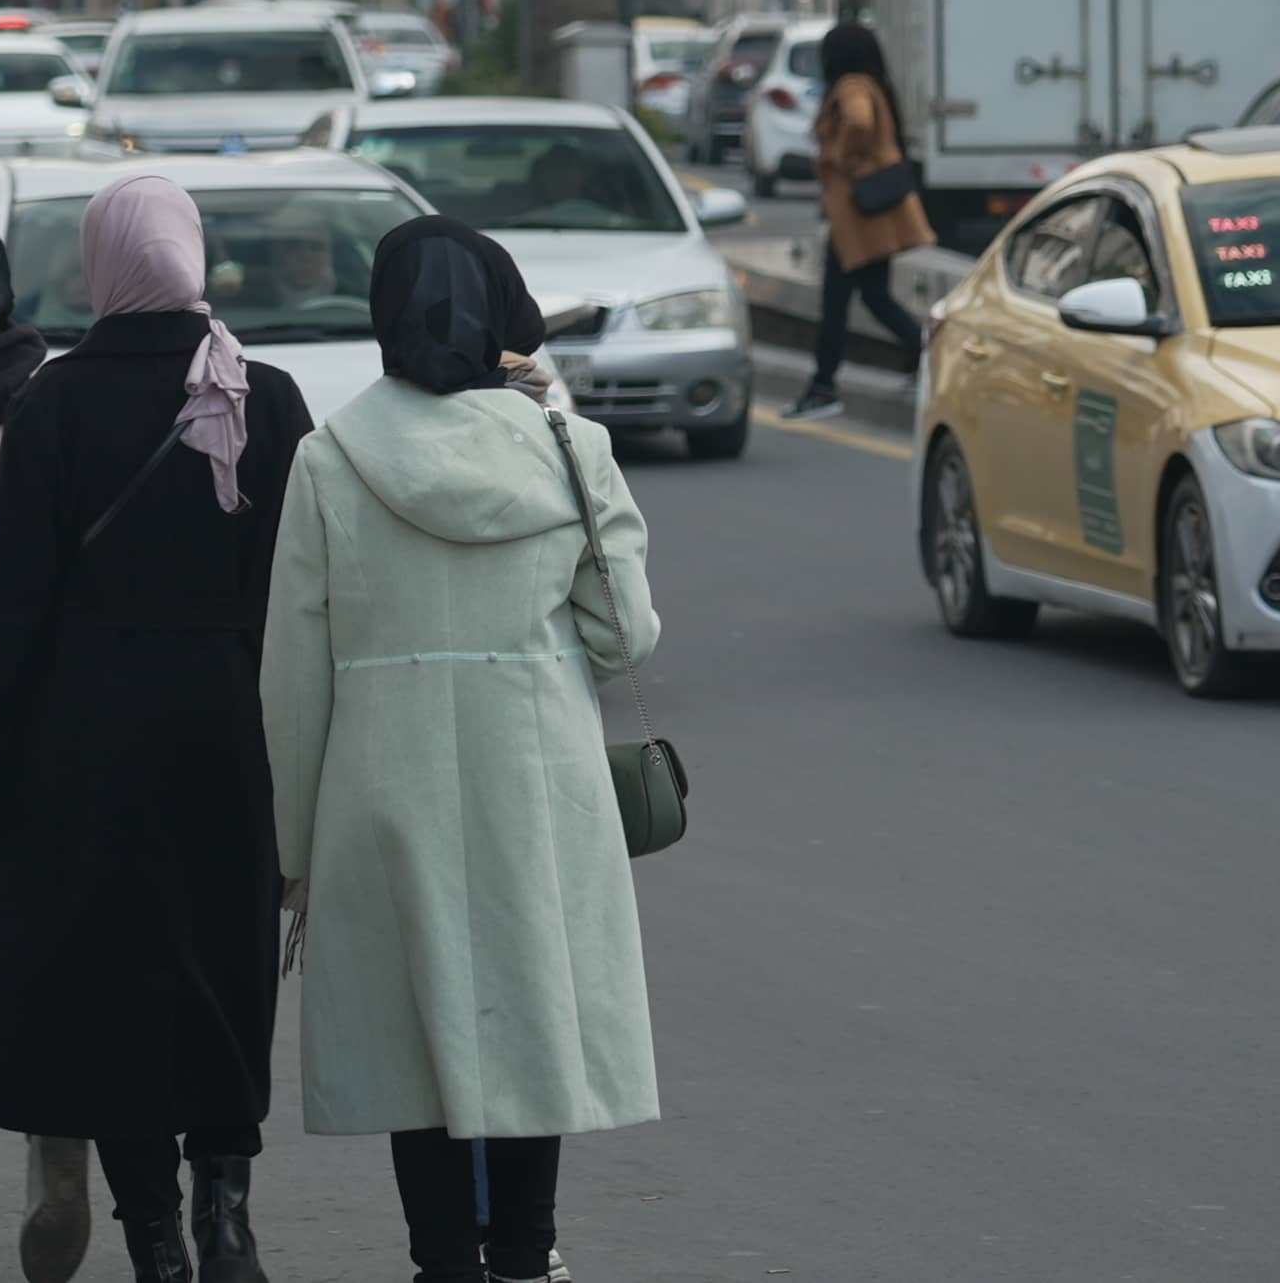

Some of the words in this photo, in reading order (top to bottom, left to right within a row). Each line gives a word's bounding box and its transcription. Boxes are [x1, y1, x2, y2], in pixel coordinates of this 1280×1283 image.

[1207, 215, 1259, 233] TAXI
[1215, 243, 1265, 261] TAXI
[1223, 269, 1272, 288] TAXI
